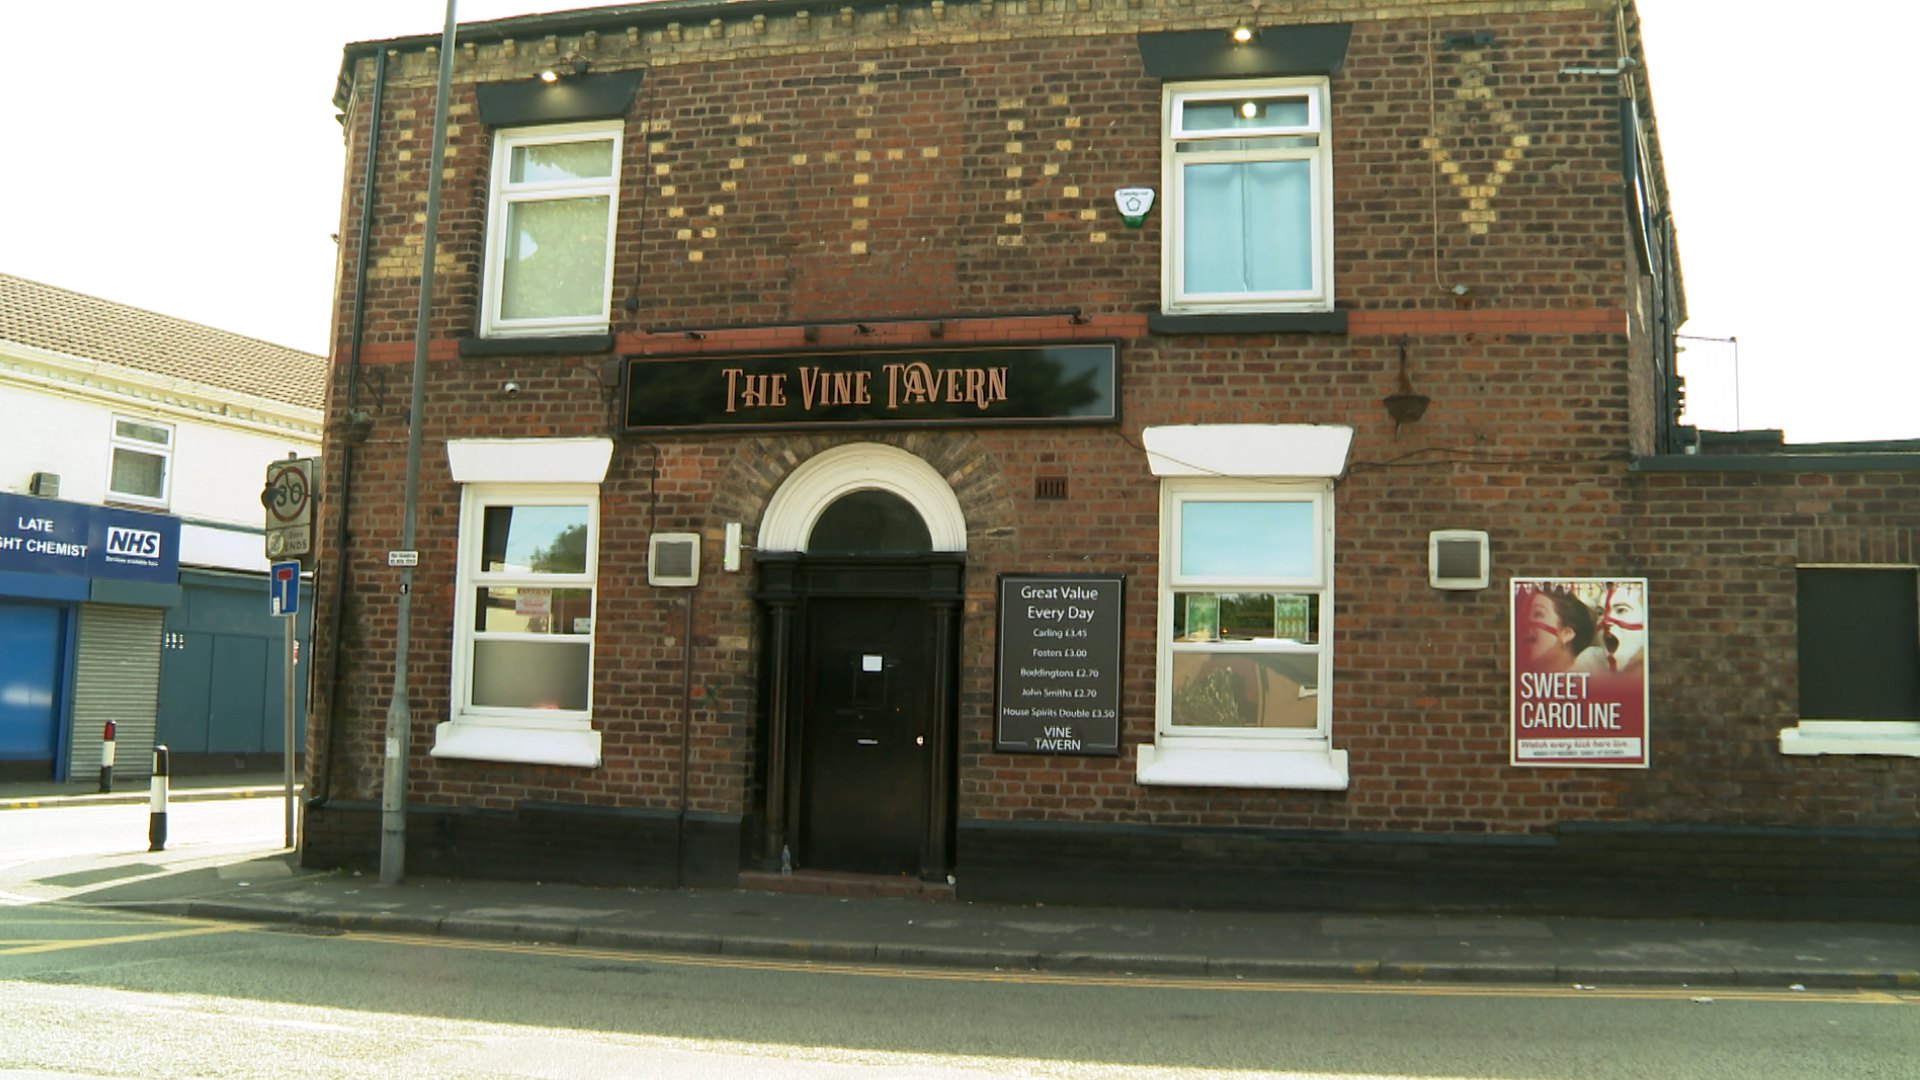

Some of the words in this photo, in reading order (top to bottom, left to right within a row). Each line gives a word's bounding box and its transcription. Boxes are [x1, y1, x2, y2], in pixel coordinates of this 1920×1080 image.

[722, 368, 787, 413] THE
[798, 366, 872, 411] VINE
[882, 362, 1008, 410] TAVERN
[276, 482, 302, 507] 30
[18, 516, 54, 533] LATE
[26, 538, 88, 558] CHEMIST
[109, 530, 157, 554] NHS
[1021, 585, 1058, 599] Great
[1060, 586, 1099, 600] Value
[1027, 605, 1065, 622] Every
[1068, 605, 1095, 622] Day
[1033, 628, 1063, 639] Carling
[1032, 648, 1063, 657] Fosters
[1064, 648, 1087, 658] £3.00
[1020, 667, 1074, 679] Boddingtons
[1075, 668, 1099, 678] £2.70
[1021, 687, 1042, 697] John
[1043, 688, 1072, 698] Smiths
[1074, 689, 1097, 698] £2.70
[1520, 672, 1591, 700] SWEET
[1003, 707, 1030, 716] House
[1031, 708, 1057, 718] Spirits
[1059, 708, 1090, 718] Double
[1091, 709, 1115, 718] £3.50
[1520, 701, 1622, 730] CAROLINE
[1043, 726, 1072, 738] VINE
[1034, 737, 1081, 751] TAVERN
